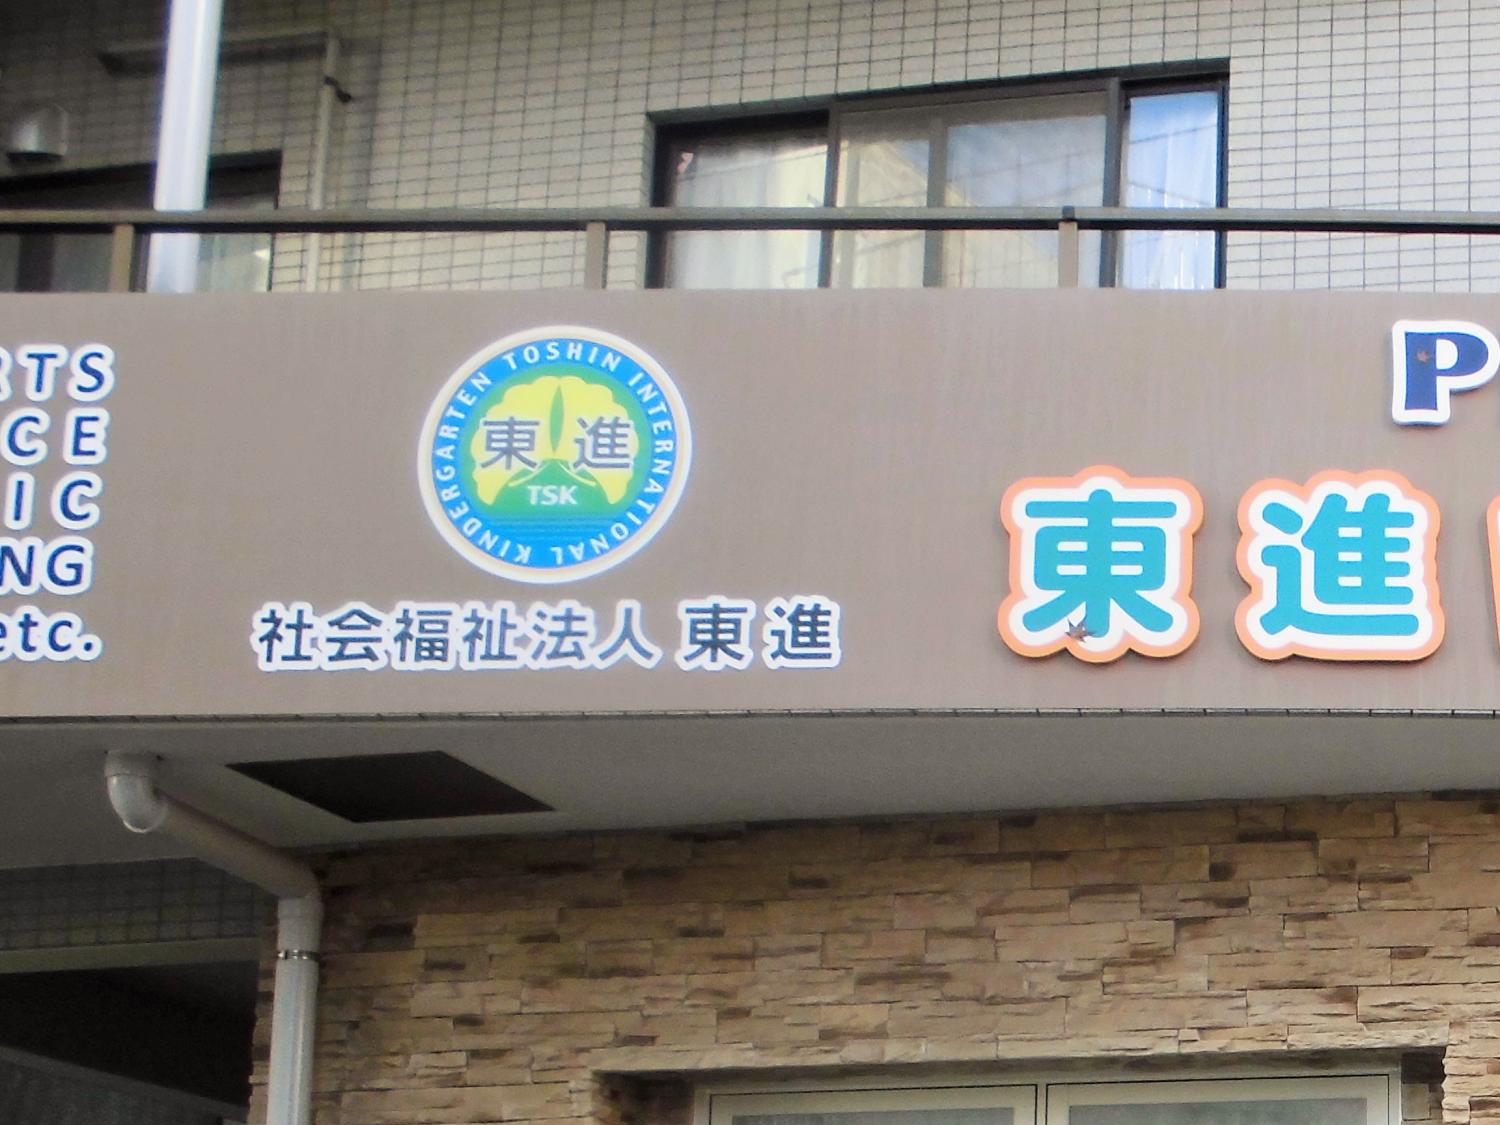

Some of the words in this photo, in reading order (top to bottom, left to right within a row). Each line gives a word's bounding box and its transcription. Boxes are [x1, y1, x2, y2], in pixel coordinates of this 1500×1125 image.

[0, 350, 106, 394] TS
[501, 341, 622, 373] TOSHIN
[435, 370, 533, 564] KINDERGARTEN
[479, 415, 632, 471] 東進
[551, 370, 676, 567] INTERNATIONAL
[527, 483, 579, 506] TSK
[1021, 488, 1420, 640] 東進
[258, 606, 656, 664] 社会福祉法人
[683, 602, 834, 663] 東進
